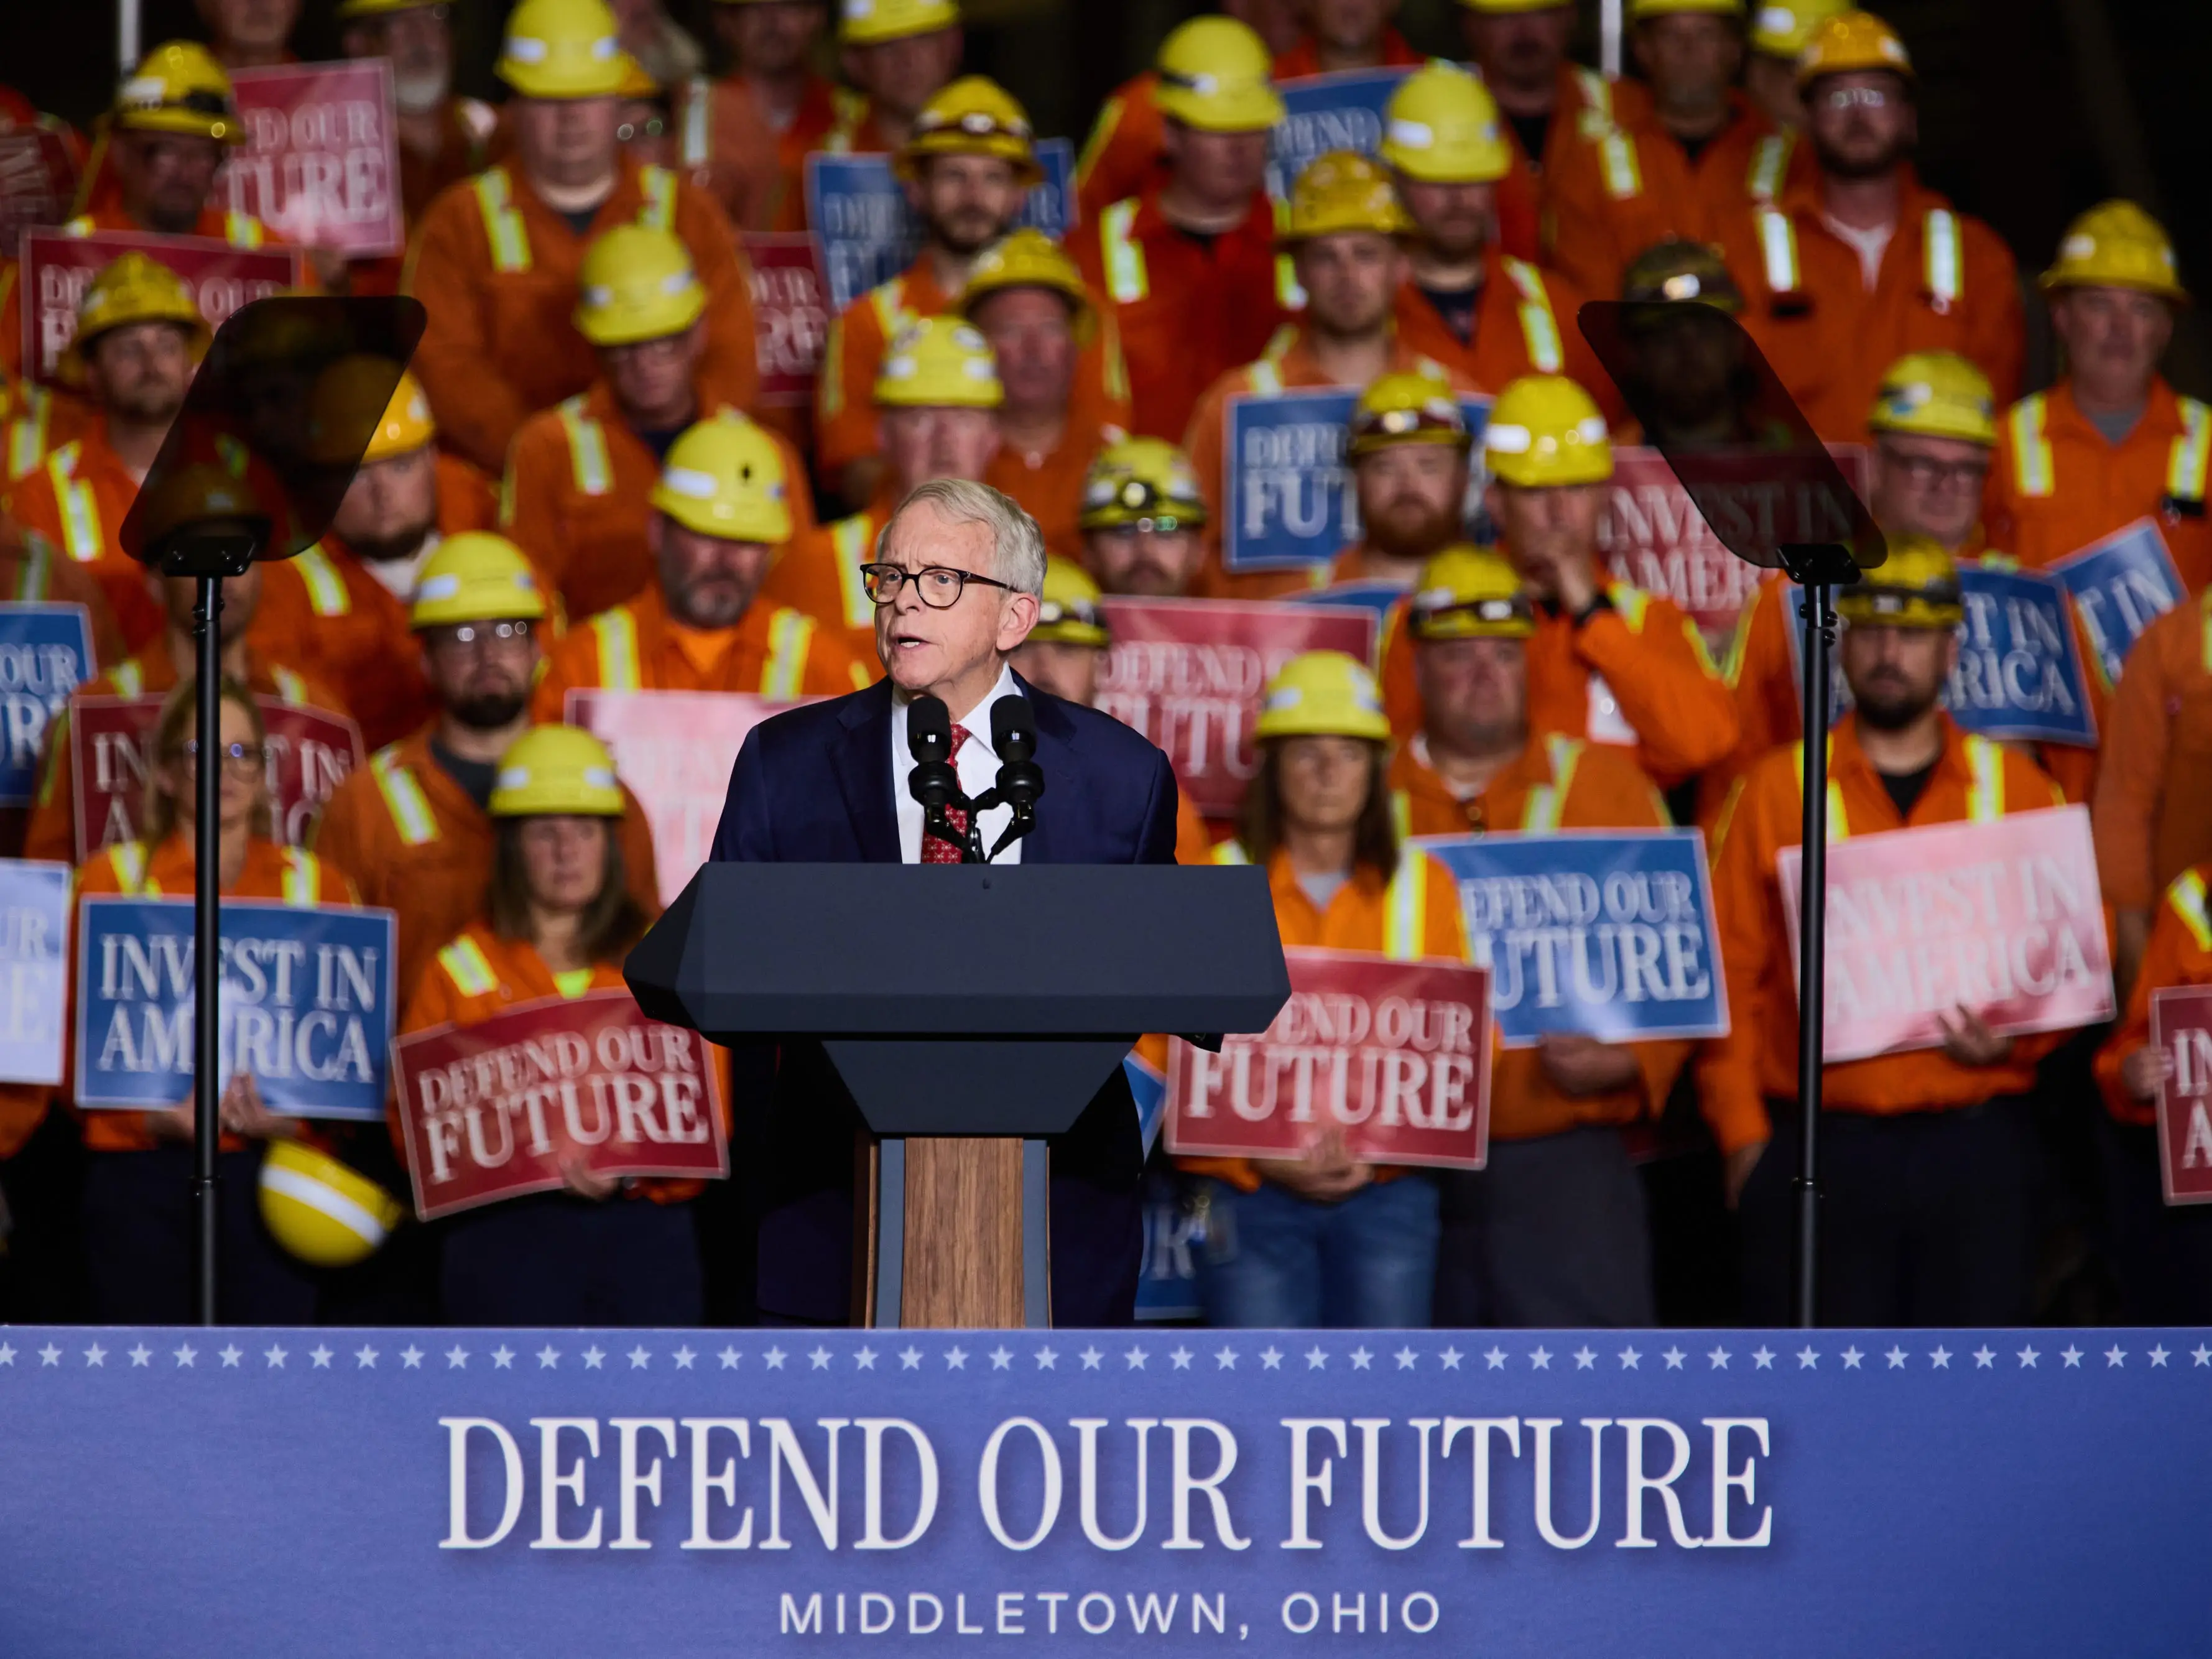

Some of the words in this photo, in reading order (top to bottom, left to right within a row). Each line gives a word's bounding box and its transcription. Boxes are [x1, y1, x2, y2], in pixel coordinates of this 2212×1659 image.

[214, 147, 389, 228] TURE
[1244, 466, 1361, 540] FUT
[1459, 872, 1601, 933] EFEND
[1603, 869, 1696, 924] OUR
[1825, 861, 2006, 951] NVEST
[98, 933, 307, 1006] INVST
[315, 943, 381, 1014] IN
[1471, 922, 1711, 1012] UTURE
[95, 1001, 376, 1084] AMRICA
[1375, 995, 1476, 1053] OUR
[417, 1030, 592, 1116] DEFEND
[595, 1023, 698, 1073] OUR
[1183, 1042, 1476, 1132] FUTURE
[422, 1071, 711, 1185] FUTURE
[438, 1416, 939, 1551] DEFEND
[978, 1416, 1252, 1551] OUR
[1279, 1416, 1772, 1550] FUTURE
[780, 1592, 1249, 1640] MIDDLETOWN,
[1282, 1592, 1439, 1633] OHIO
